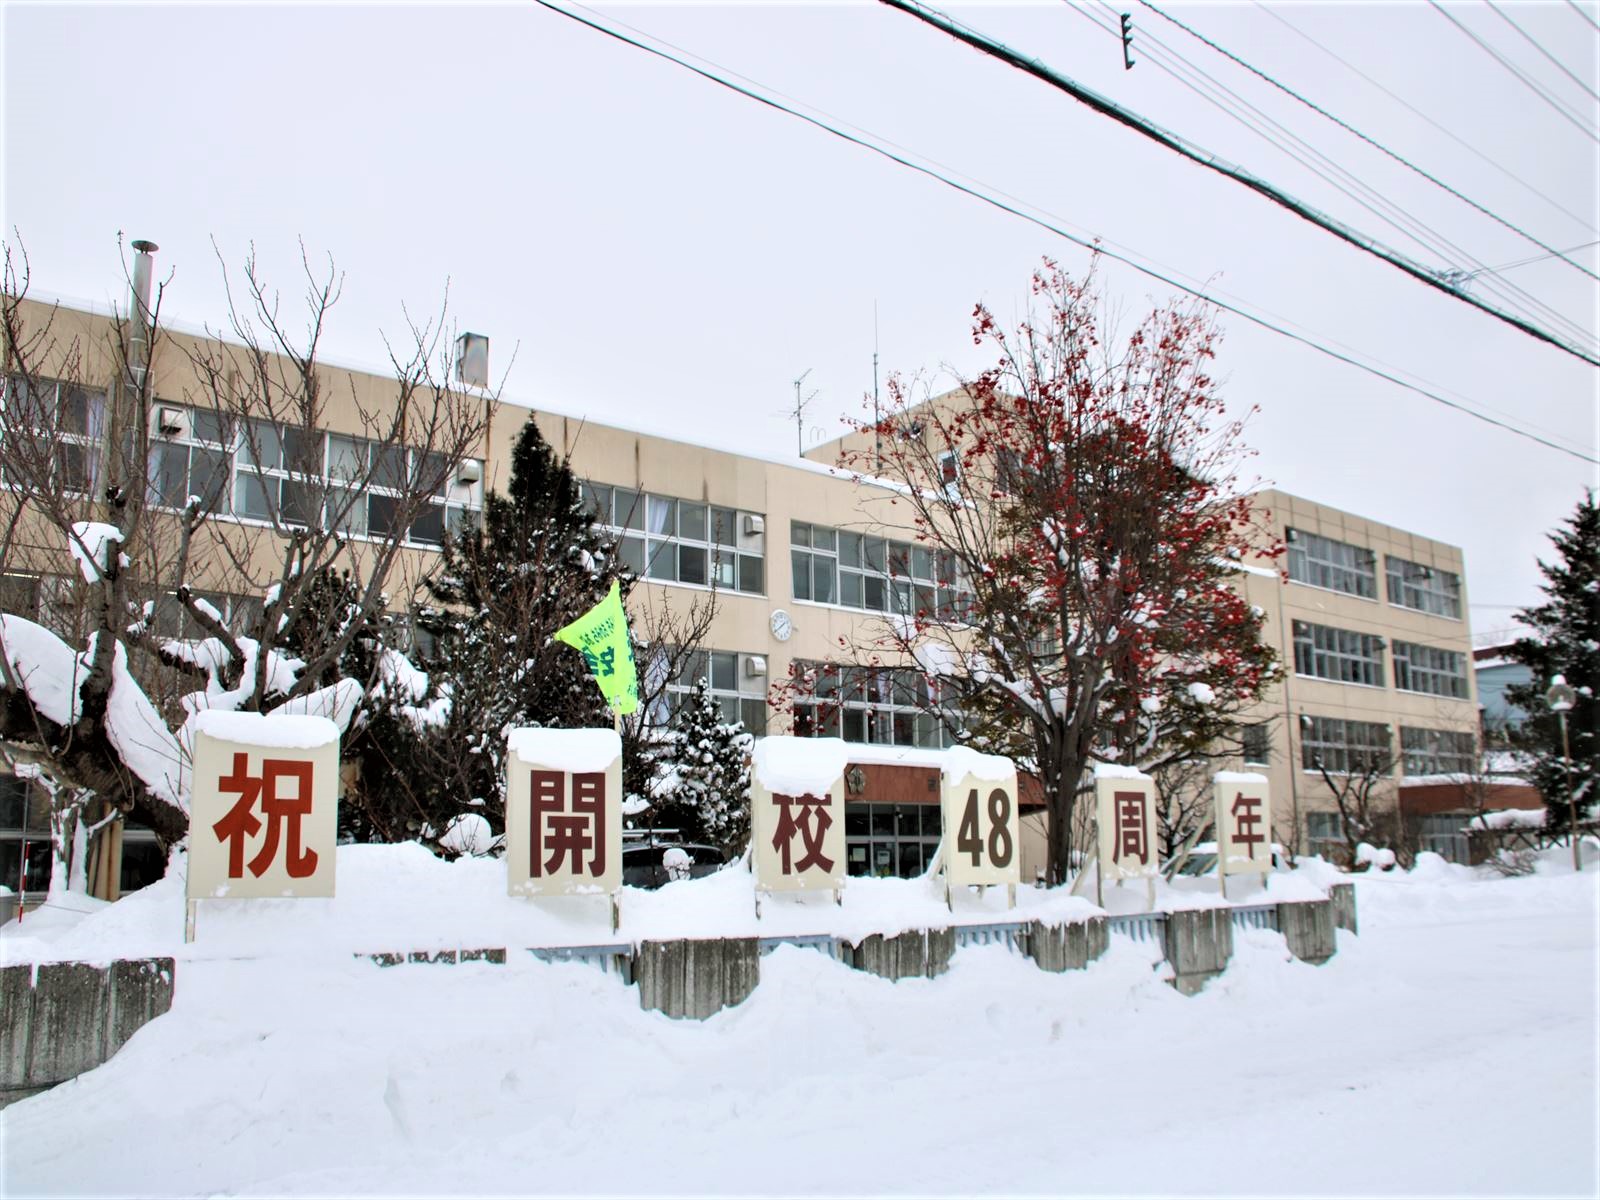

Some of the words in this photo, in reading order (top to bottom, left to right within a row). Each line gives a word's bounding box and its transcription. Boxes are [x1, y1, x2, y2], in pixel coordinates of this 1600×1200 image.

[212, 752, 318, 878] 祝
[530, 769, 606, 878] 開
[772, 792, 835, 875] 校
[957, 788, 1013, 868] 48
[1113, 791, 1149, 865] 周
[1231, 791, 1265, 860] 年
